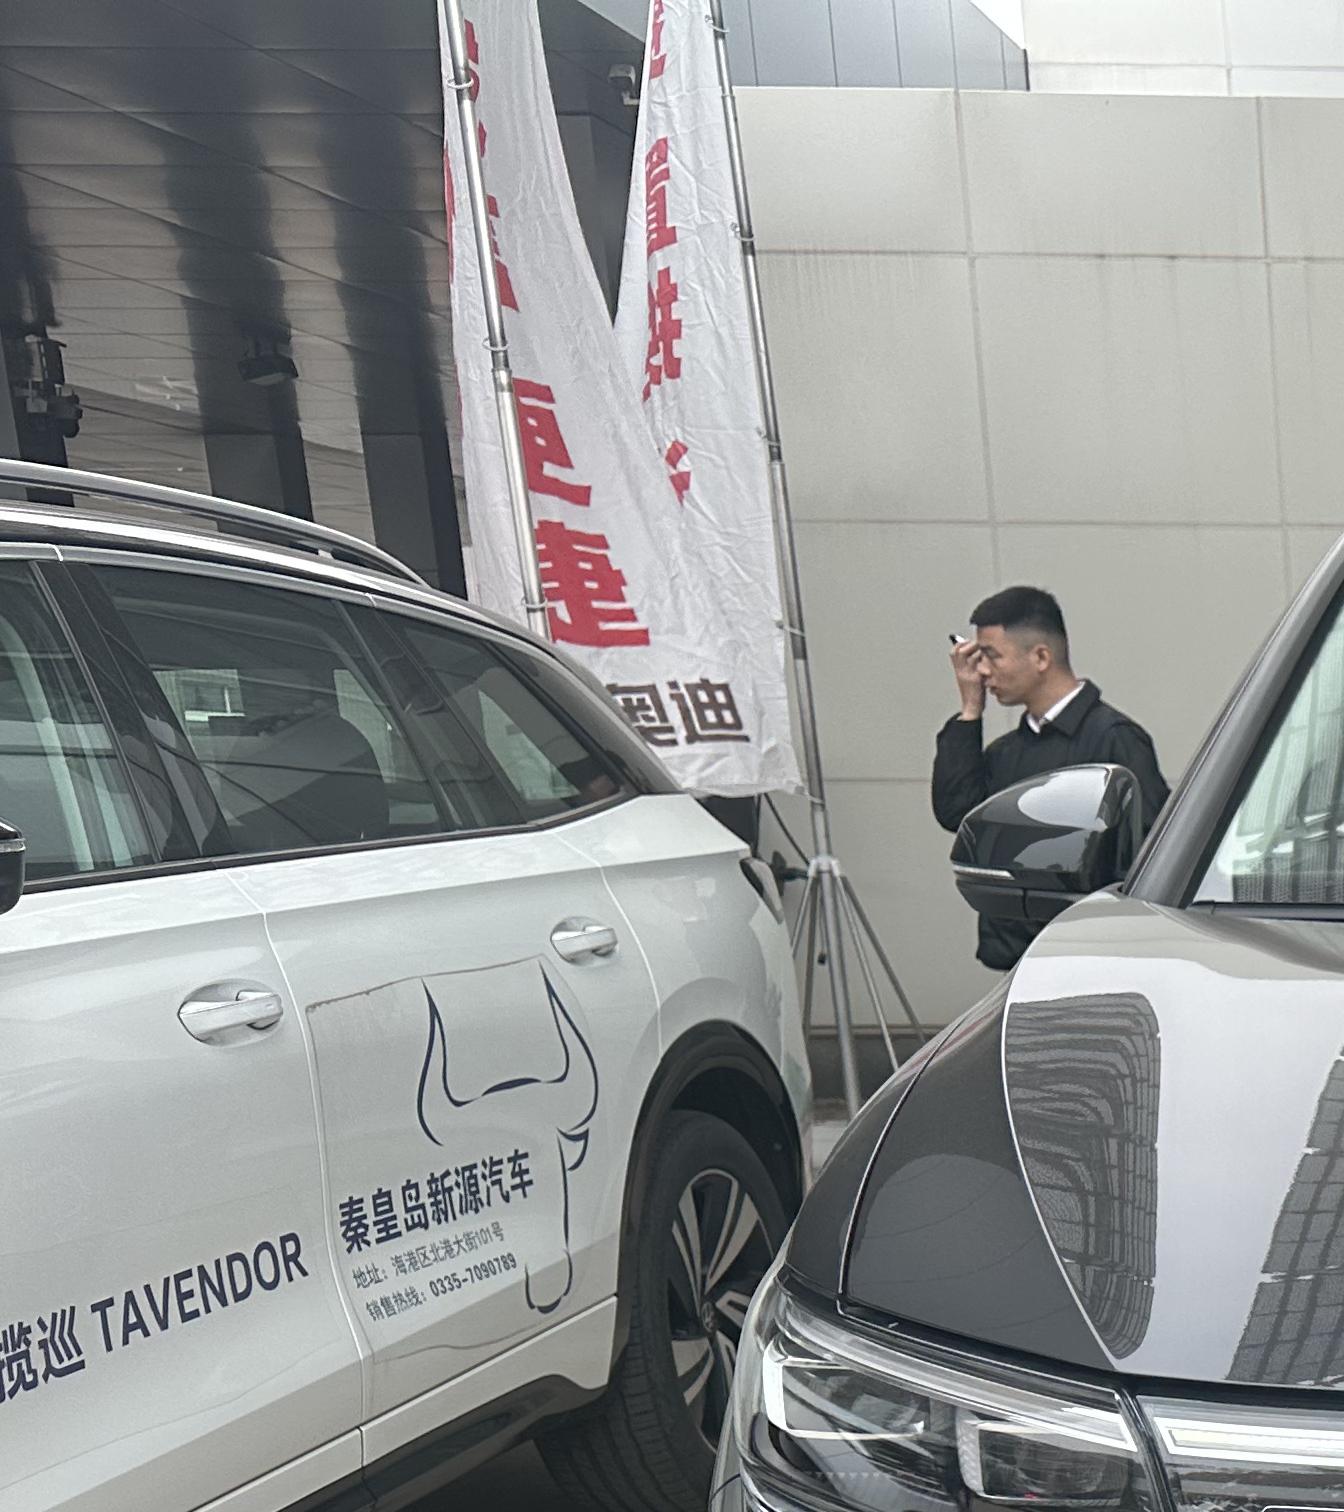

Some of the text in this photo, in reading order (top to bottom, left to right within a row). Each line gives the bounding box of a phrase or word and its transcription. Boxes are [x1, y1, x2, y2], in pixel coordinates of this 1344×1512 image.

[339, 1148, 534, 1255] 秦皇岛新源汽车
[0, 1232, 309, 1403] 揽巡 TAVENDOR
